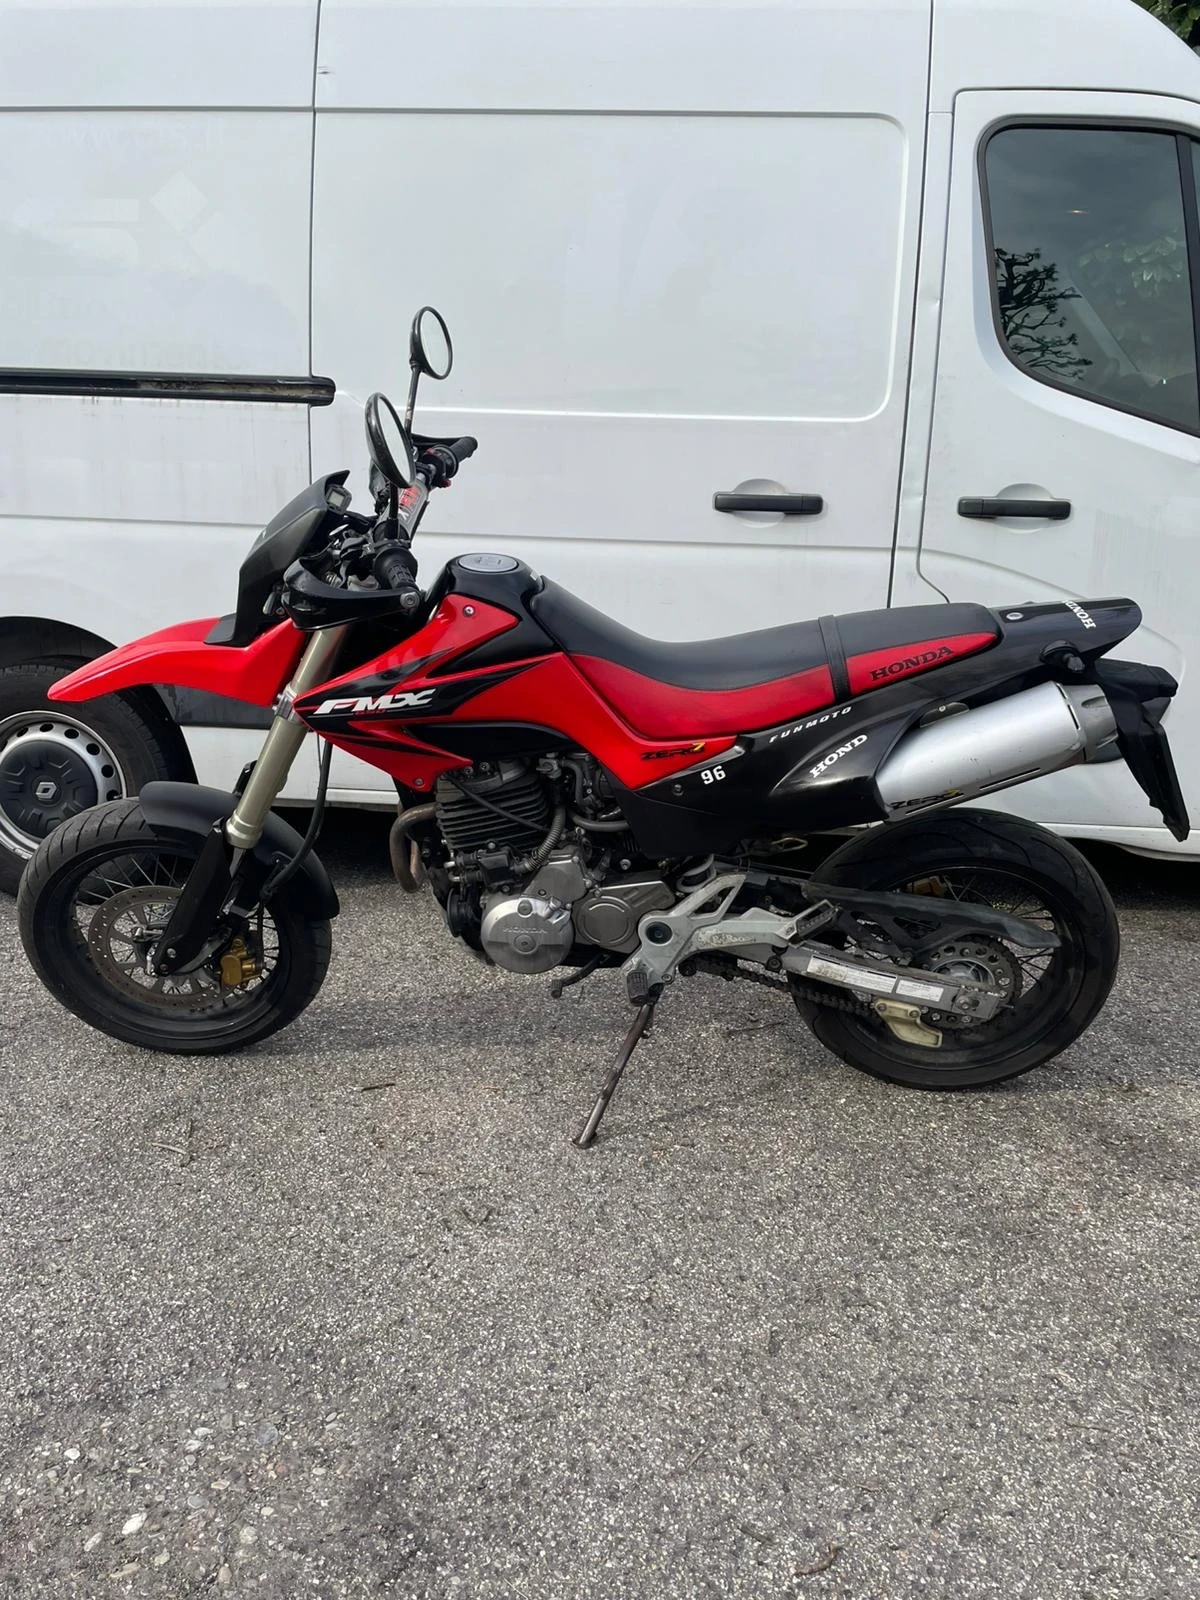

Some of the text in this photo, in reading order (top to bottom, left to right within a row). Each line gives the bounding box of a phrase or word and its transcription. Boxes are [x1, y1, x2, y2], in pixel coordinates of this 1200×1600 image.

[1062, 600, 1096, 629] HOND
[870, 646, 954, 681] HONDA
[313, 688, 436, 715] FMX
[768, 706, 852, 743] FUNMOTO
[809, 734, 868, 778] HOND
[700, 765, 726, 785] 96
